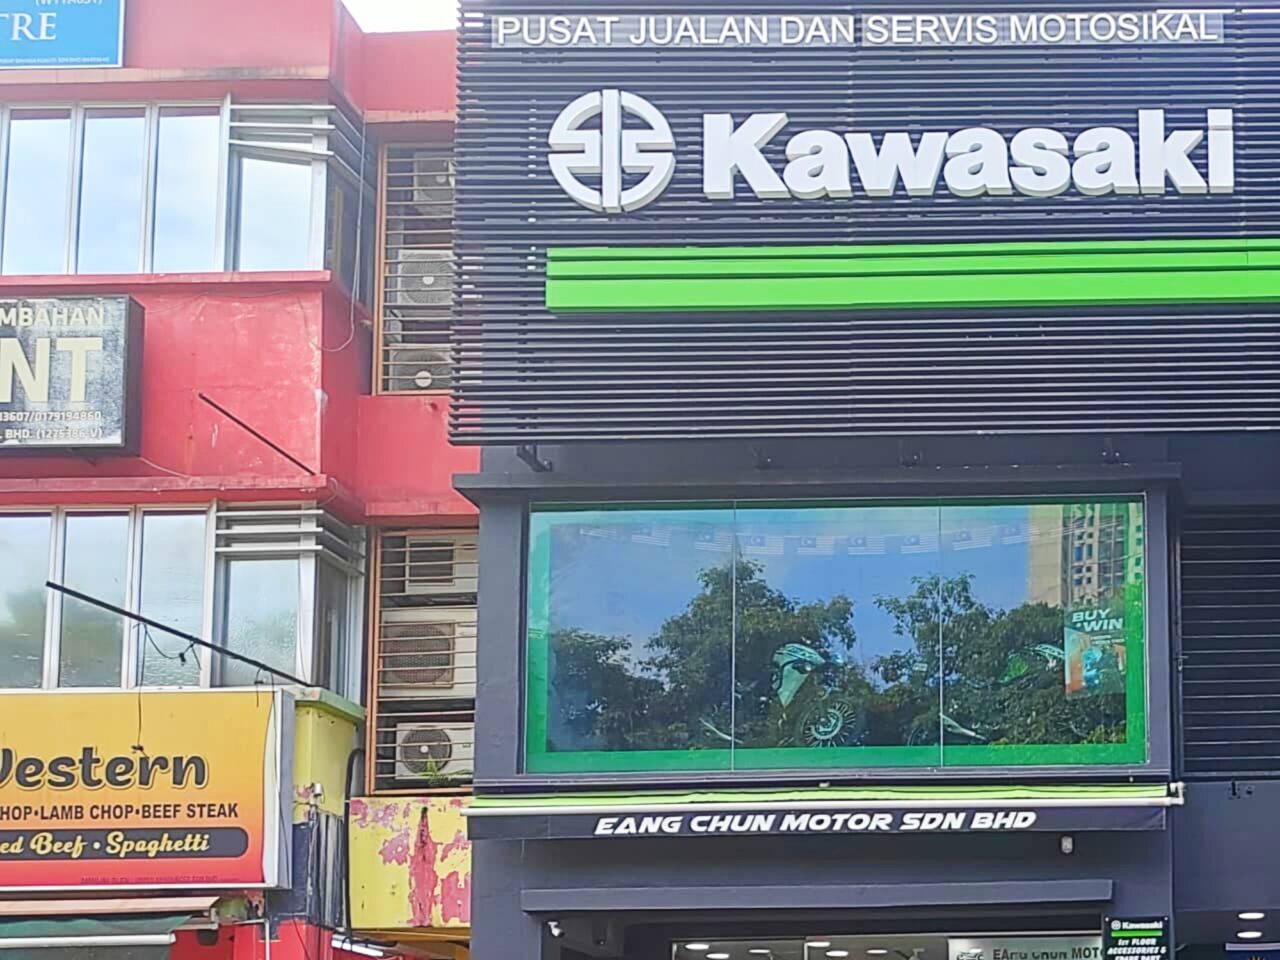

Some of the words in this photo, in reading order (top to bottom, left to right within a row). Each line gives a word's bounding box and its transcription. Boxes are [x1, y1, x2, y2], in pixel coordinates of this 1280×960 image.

[497, 17, 619, 45] PUSAT
[630, 15, 775, 44] JUALAN
[781, 15, 854, 43] DAN
[866, 14, 998, 43] SERVIS
[1009, 12, 1219, 42] MOTOSIKAL
[702, 108, 1235, 199] Kawasaki
[1072, 608, 1111, 622] BUY
[1083, 618, 1123, 631] WIN
[186, 803, 239, 818] STEAK
[594, 816, 682, 835] EANG
[690, 815, 773, 833] CHUN
[780, 813, 892, 832] MOTOR
[900, 812, 963, 830] SDN
[970, 811, 1037, 829] BHD
[30, 832, 87, 858] Beef
[106, 831, 209, 857] Spaghetti
[1122, 921, 1163, 929] Kawasaki
[1131, 938, 1157, 946] FLOOR
[1071, 947, 1103, 959] MOT
[1107, 946, 1159, 955] ACCESSORIES
